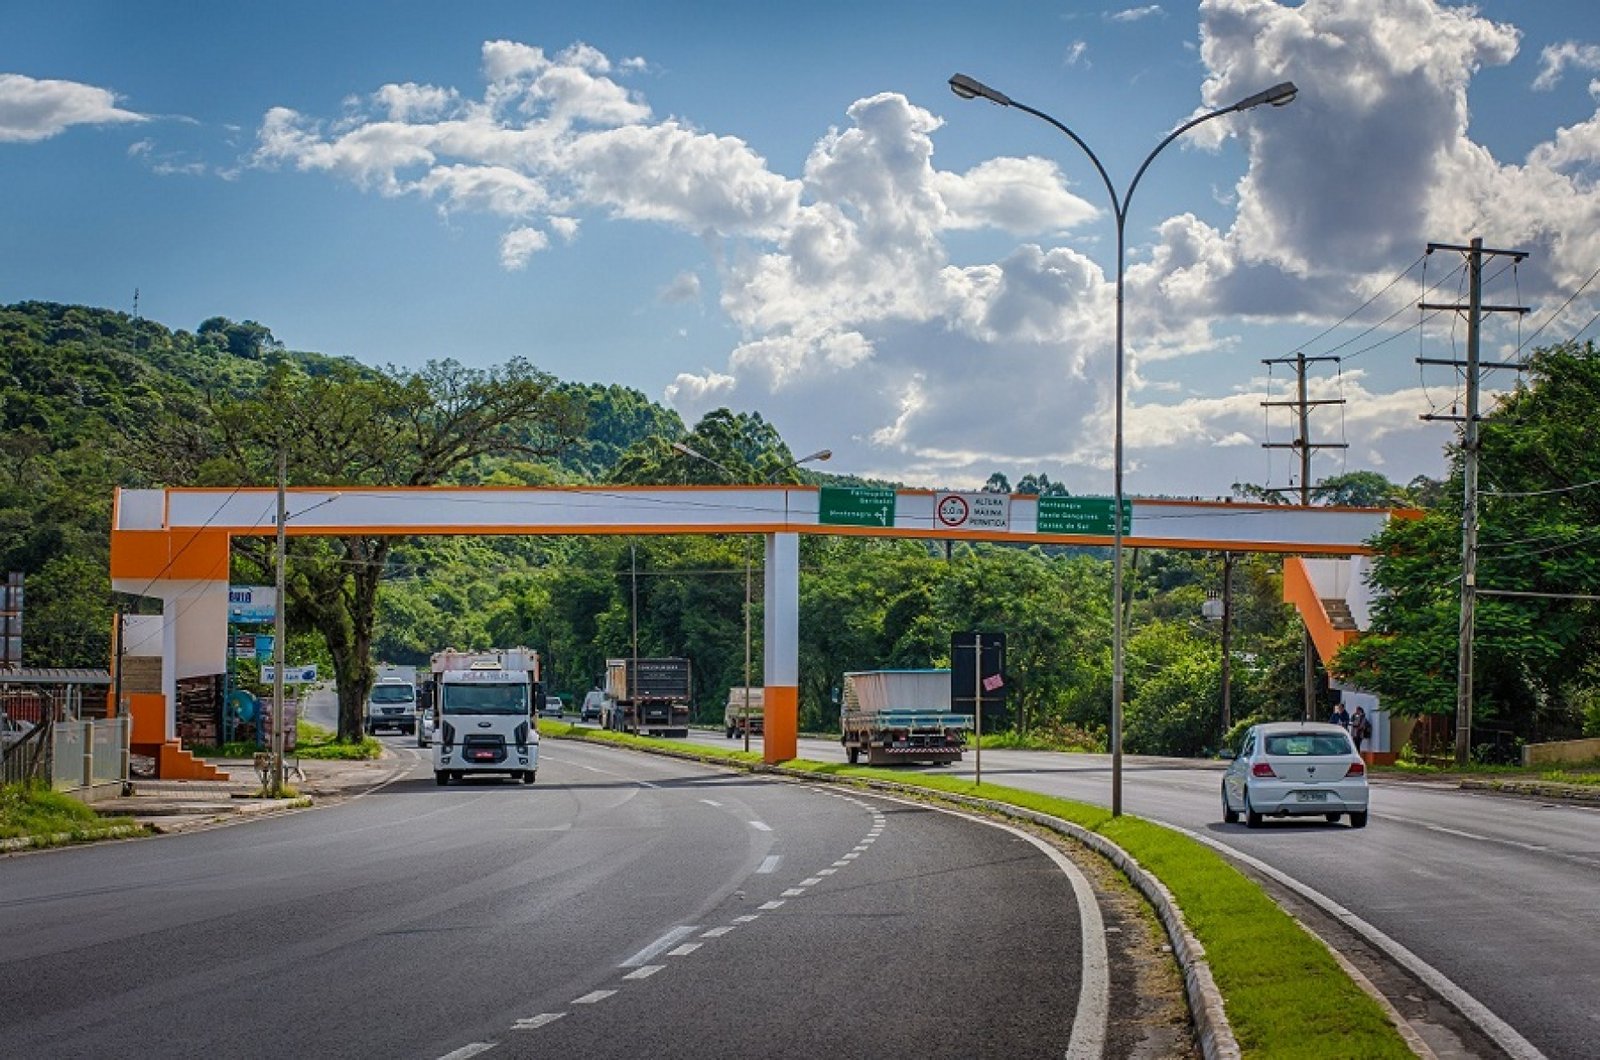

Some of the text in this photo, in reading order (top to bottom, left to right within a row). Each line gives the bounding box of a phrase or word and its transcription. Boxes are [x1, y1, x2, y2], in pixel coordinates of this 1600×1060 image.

[974, 498, 1003, 506] ALTURA
[1040, 501, 1082, 510] Montenegro
[968, 518, 1007, 528] PERMITIDA
[1077, 522, 1090, 530] Sul
